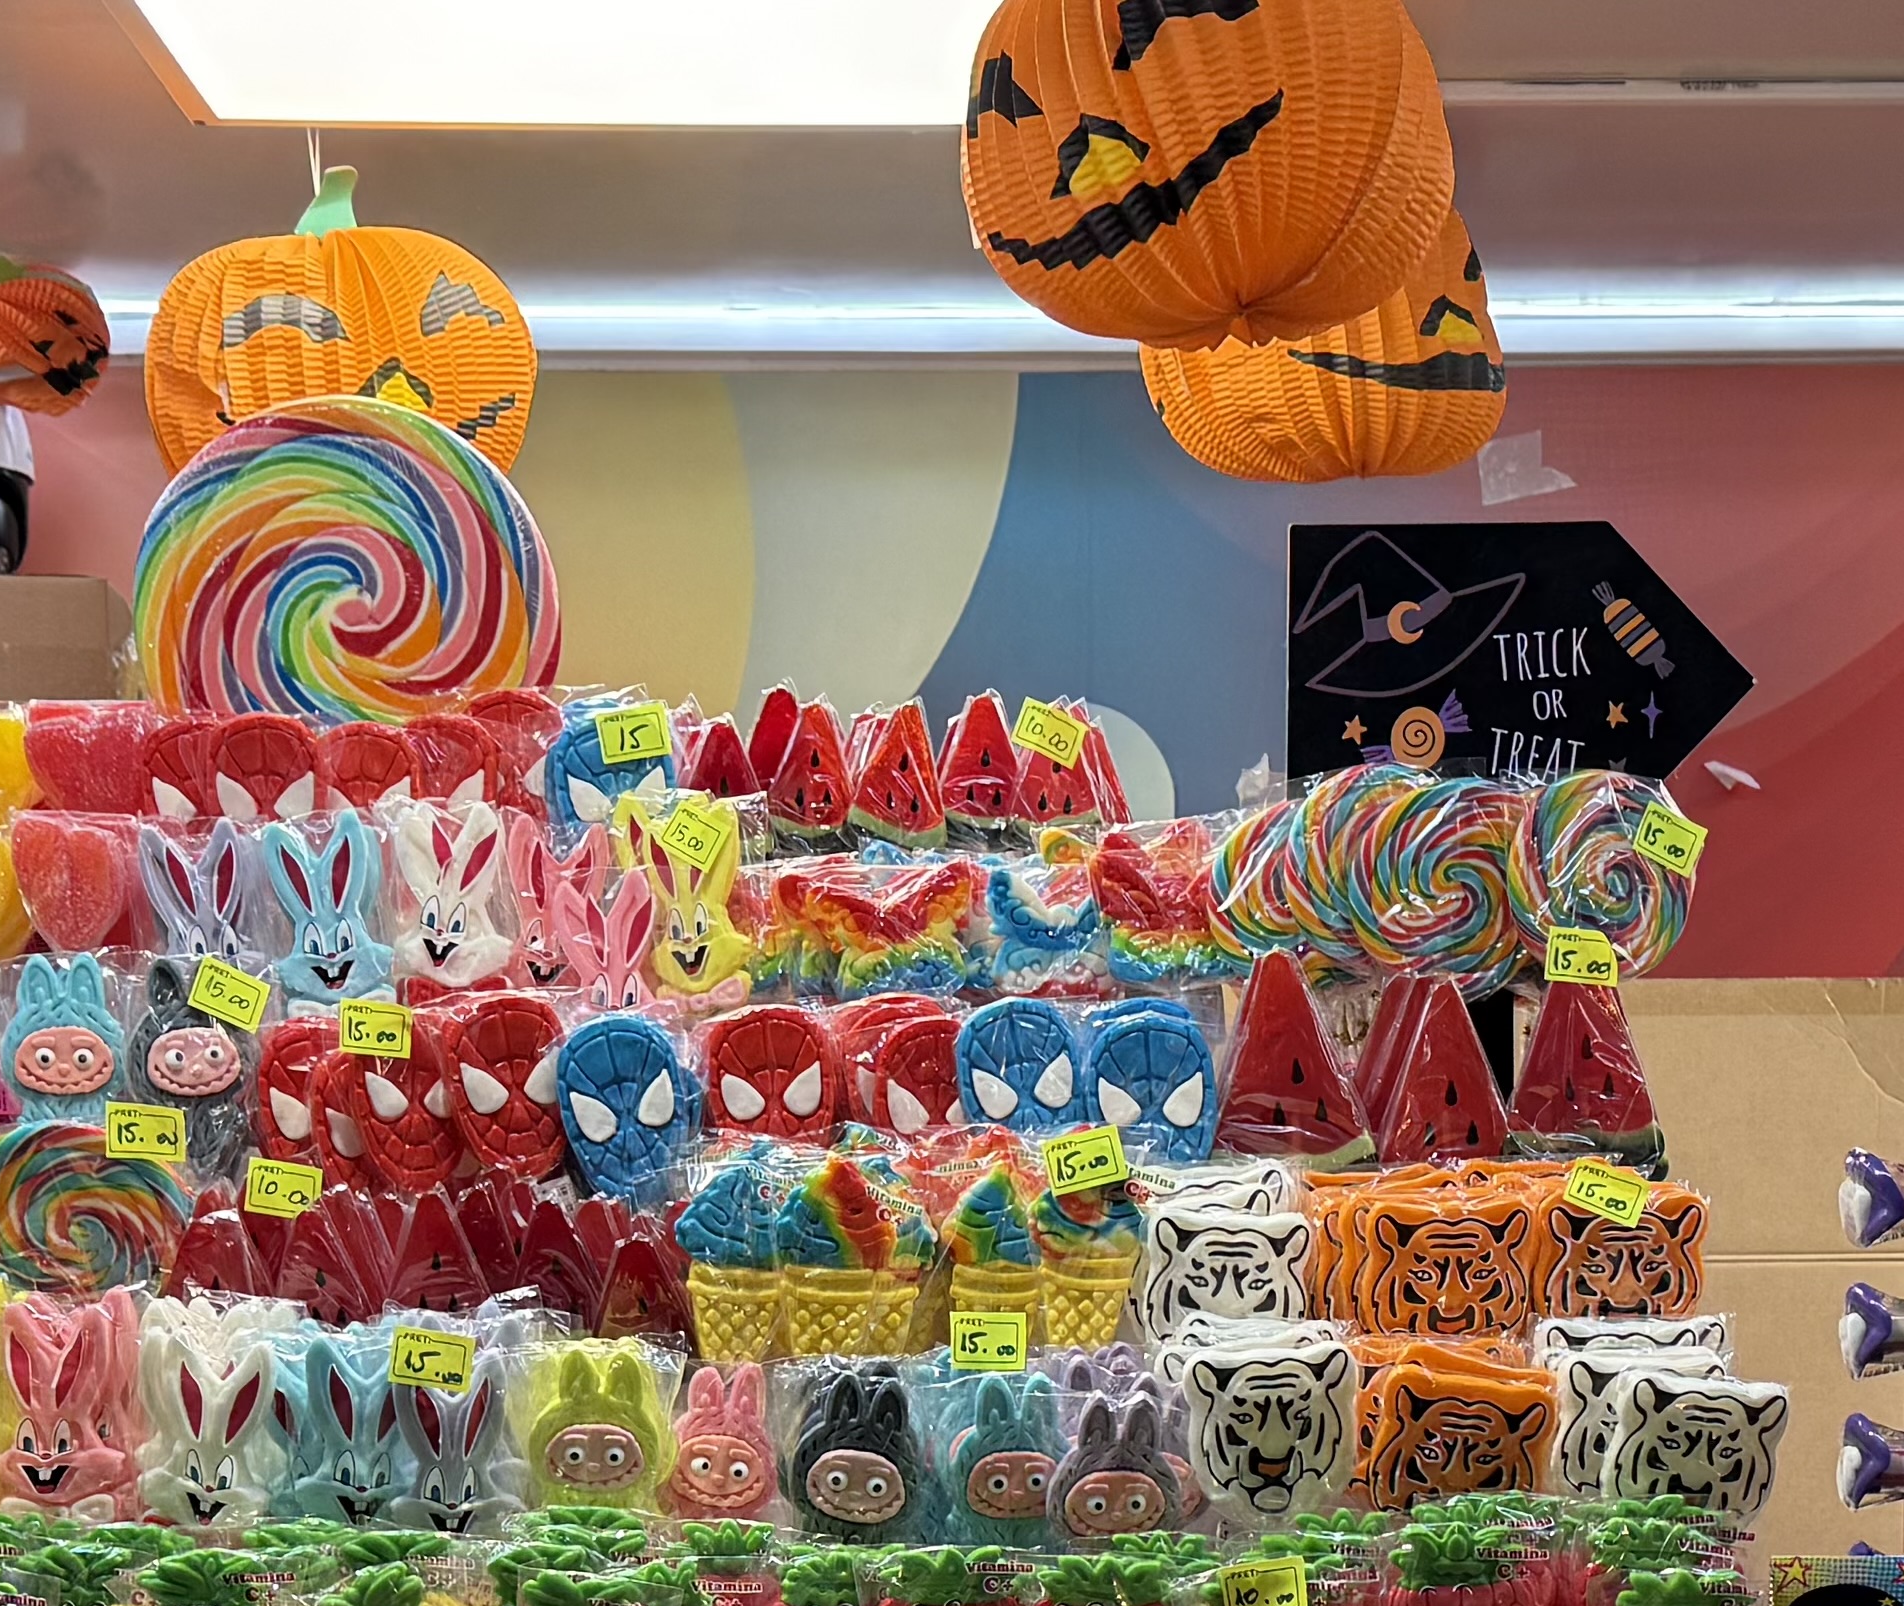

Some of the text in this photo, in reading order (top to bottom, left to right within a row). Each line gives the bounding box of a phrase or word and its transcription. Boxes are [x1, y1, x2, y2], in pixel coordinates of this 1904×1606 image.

[1492, 626, 1591, 682] TRICK
[1532, 688, 1567, 721] OR
[620, 724, 649, 751] 15
[1025, 721, 1068, 752] 10.00
[1490, 726, 1586, 783] TREAT
[671, 822, 704, 851] 15.00
[1643, 822, 1685, 858] 15.00
[1554, 947, 1611, 975] 15.00
[205, 977, 250, 1010] 15.00
[348, 1020, 396, 1043] 15.00
[1056, 1152, 1109, 1182] 15.00
[866, 1186, 923, 1215] Vitamina
[960, 1332, 1016, 1357] 15.00
[965, 1561, 1034, 1573] Vitamina
[1477, 1547, 1549, 1559] Vitamina
[223, 1572, 295, 1584] Vitamina
[691, 1581, 762, 1593] Vitamina
